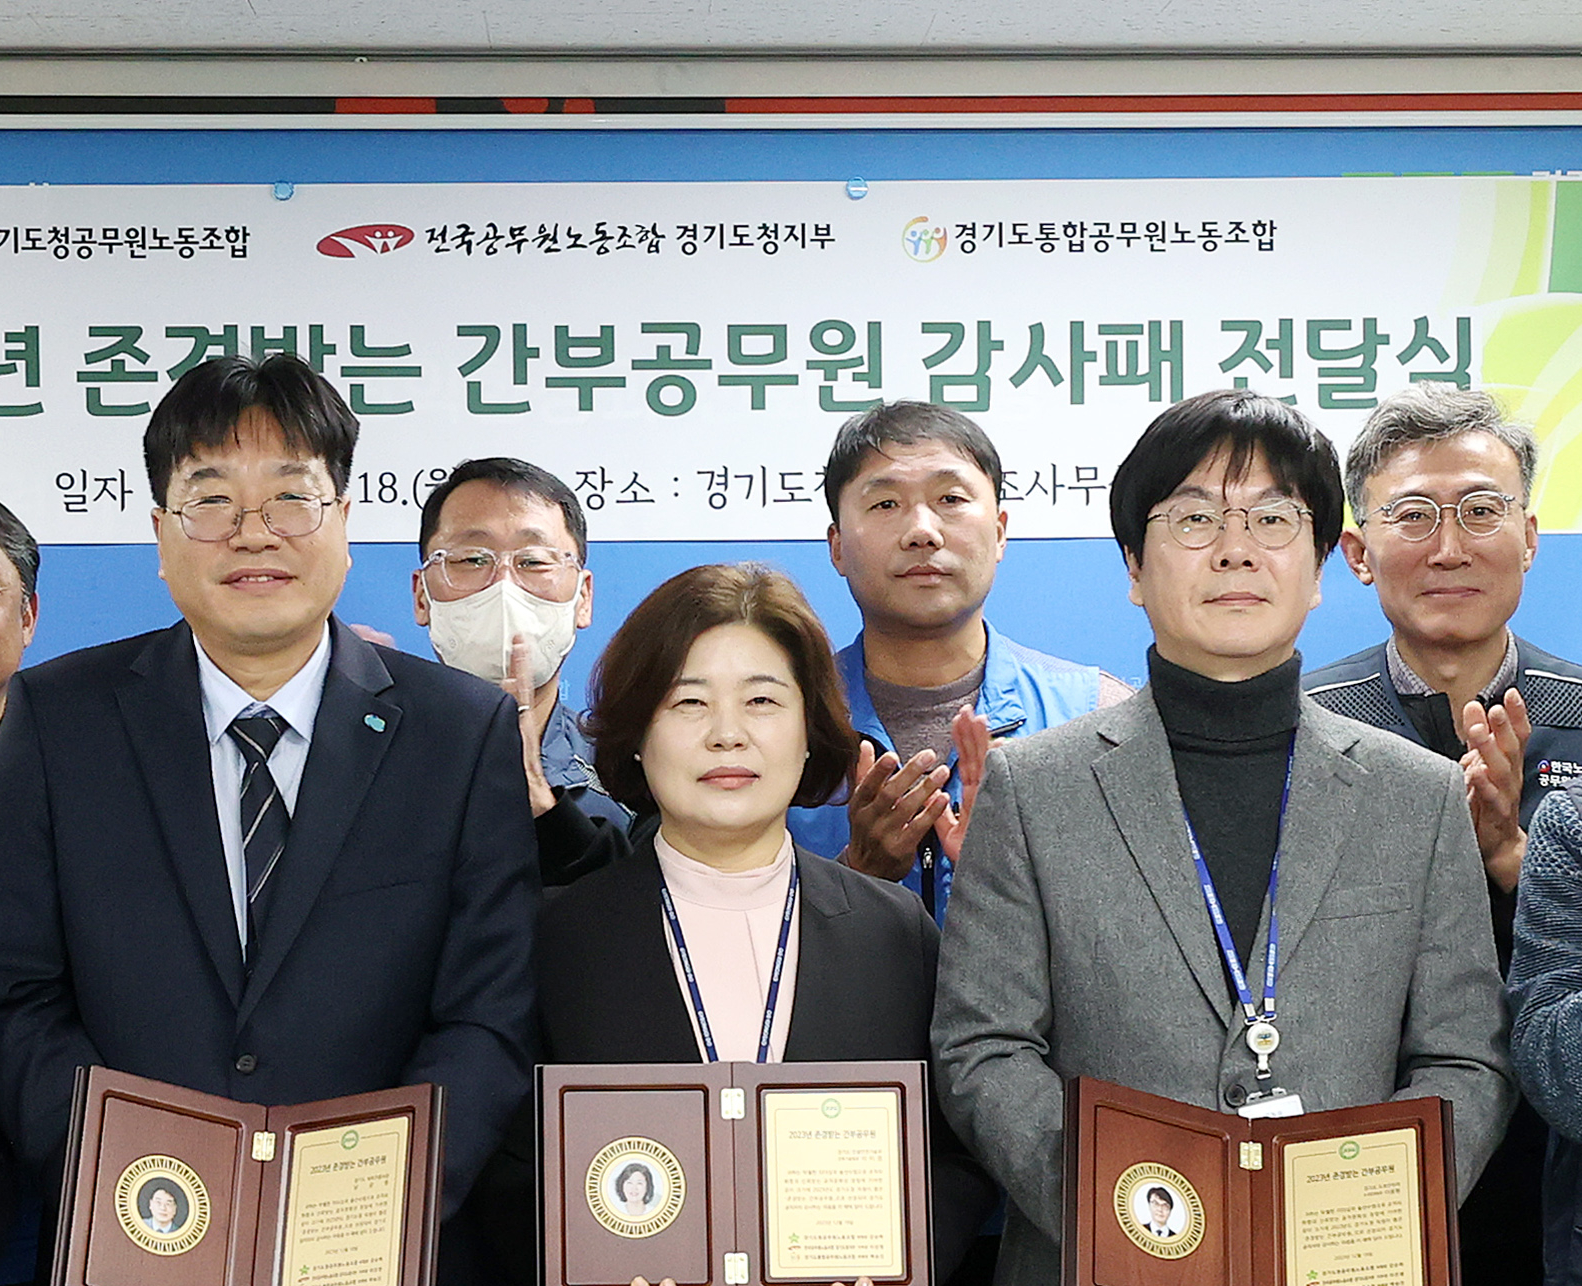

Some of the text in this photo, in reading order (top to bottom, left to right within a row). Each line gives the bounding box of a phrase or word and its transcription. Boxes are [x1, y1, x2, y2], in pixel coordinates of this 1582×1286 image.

[425, 222, 835, 256] 전국공무원노동조합 경기도청지부
[955, 220, 1277, 254] 경기도통합공무원노동조합
[457, 320, 885, 417] 간부공무원
[920, 316, 1184, 413] 감사패
[1218, 315, 1471, 409] 전달식
[56, 469, 133, 512] 일자
[575, 466, 655, 510] 장소
[696, 464, 825, 509] 경기도
[997, 464, 1121, 506] 조사무
